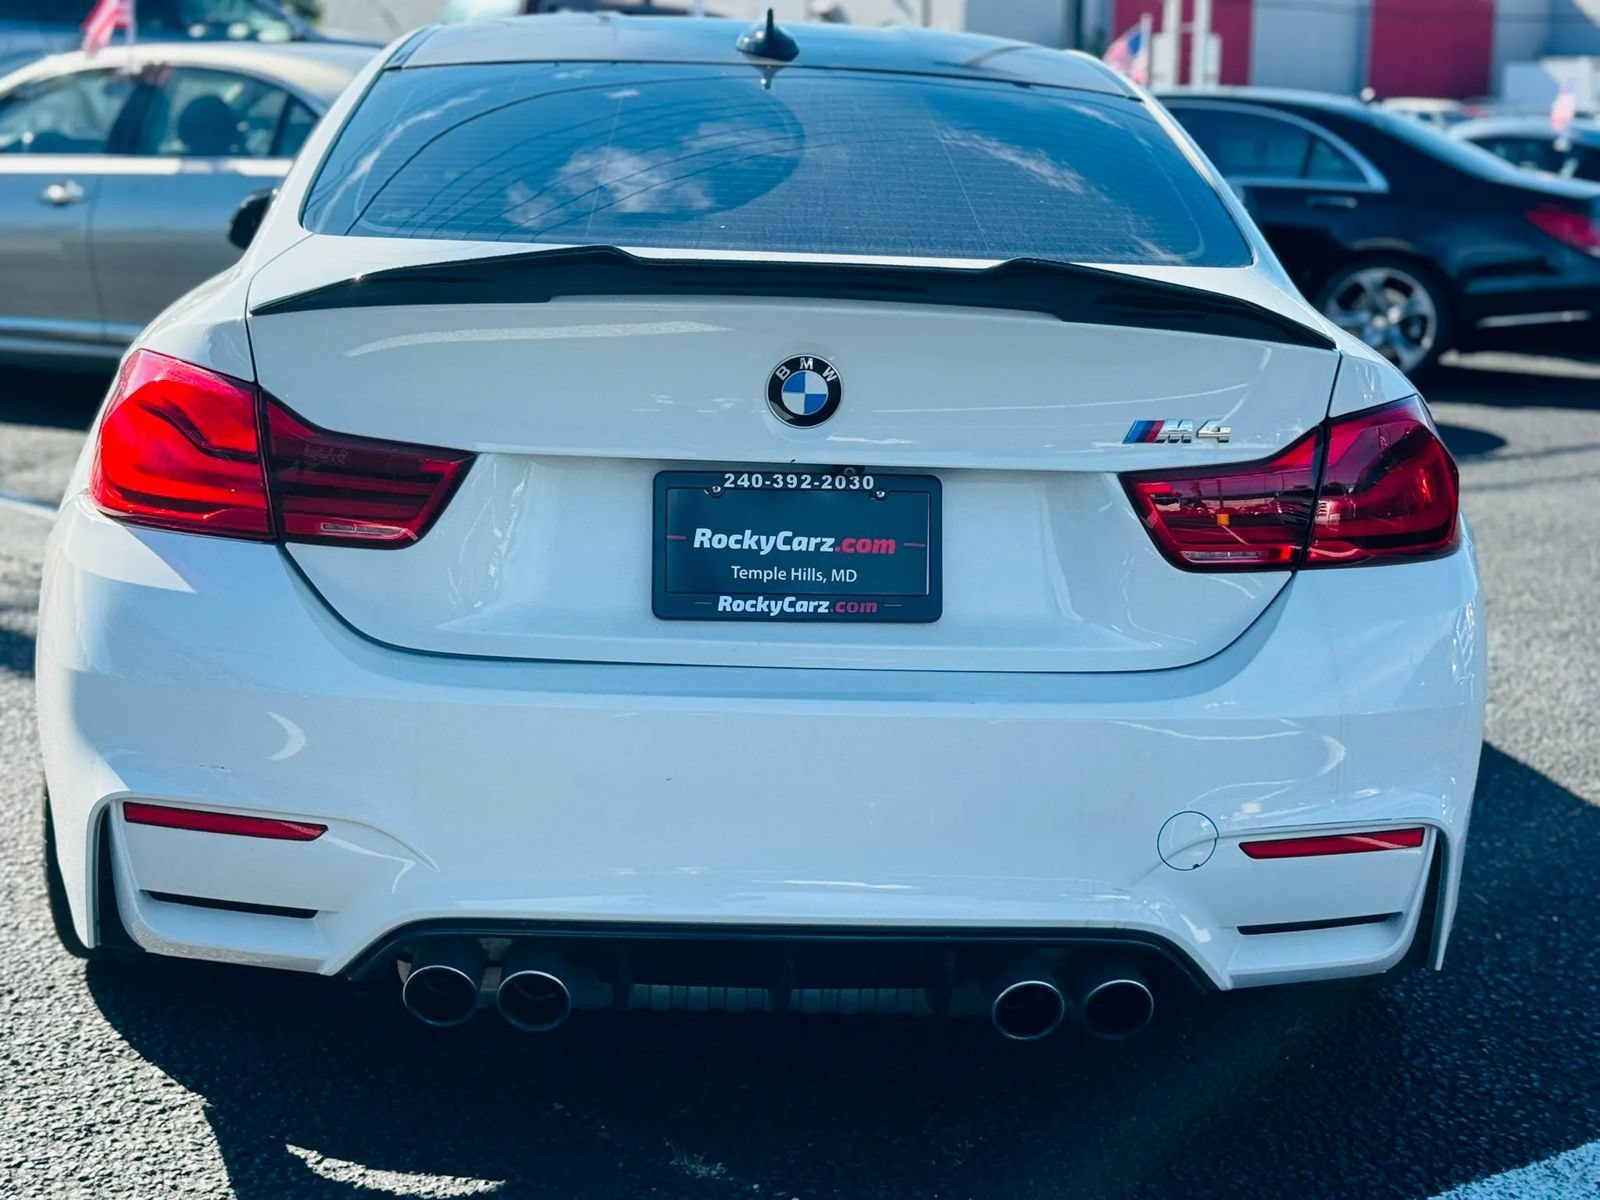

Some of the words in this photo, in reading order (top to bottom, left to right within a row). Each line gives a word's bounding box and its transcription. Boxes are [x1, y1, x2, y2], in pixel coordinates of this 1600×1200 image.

[775, 357, 838, 382] BMW
[1156, 419, 1231, 443] M4
[723, 473, 874, 490] 240-392-2030
[693, 527, 896, 555] RockyCarz.com
[731, 565, 787, 582] Temple
[790, 567, 828, 583] Hills,
[831, 568, 857, 583] MD
[717, 595, 878, 616] RockyCarz.com
